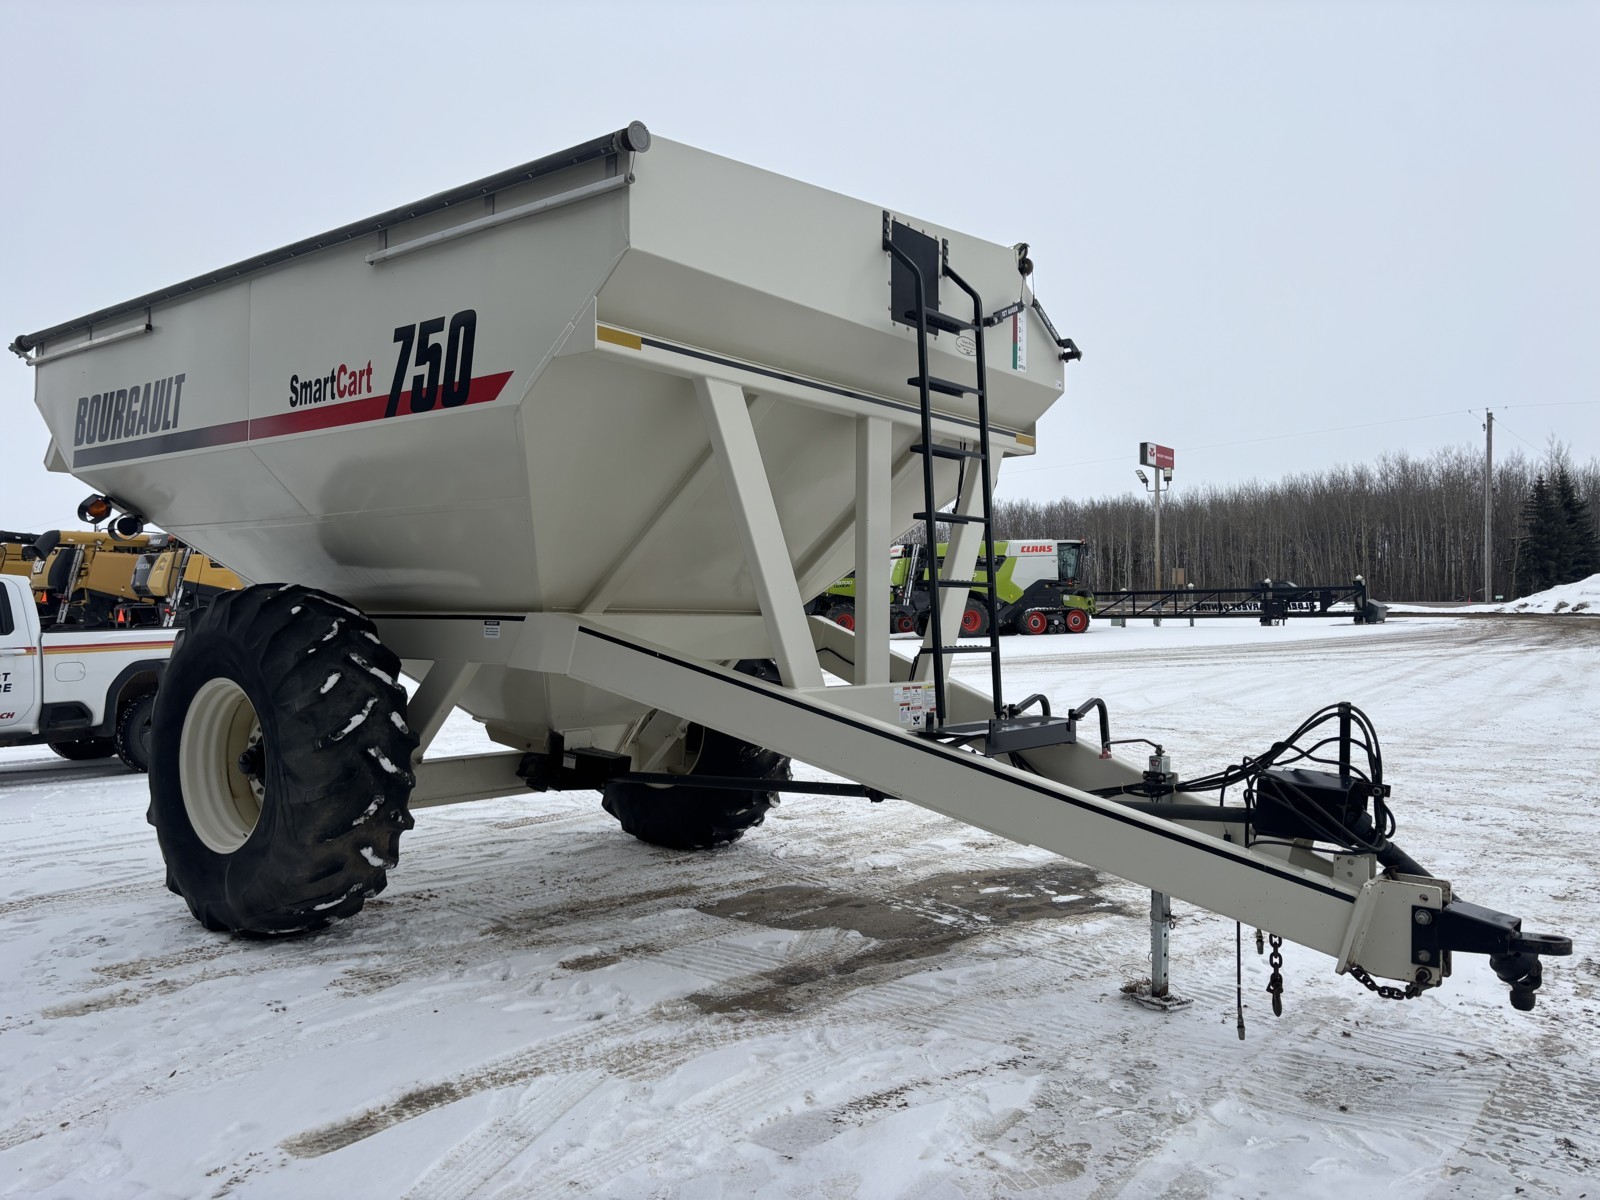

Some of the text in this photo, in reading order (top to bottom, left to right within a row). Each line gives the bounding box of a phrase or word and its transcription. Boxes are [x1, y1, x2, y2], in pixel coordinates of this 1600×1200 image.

[289, 359, 373, 408] SmartCart
[384, 309, 477, 419] 750
[74, 373, 186, 447] BOURGAULT
[1020, 545, 1053, 553] CLAAS
